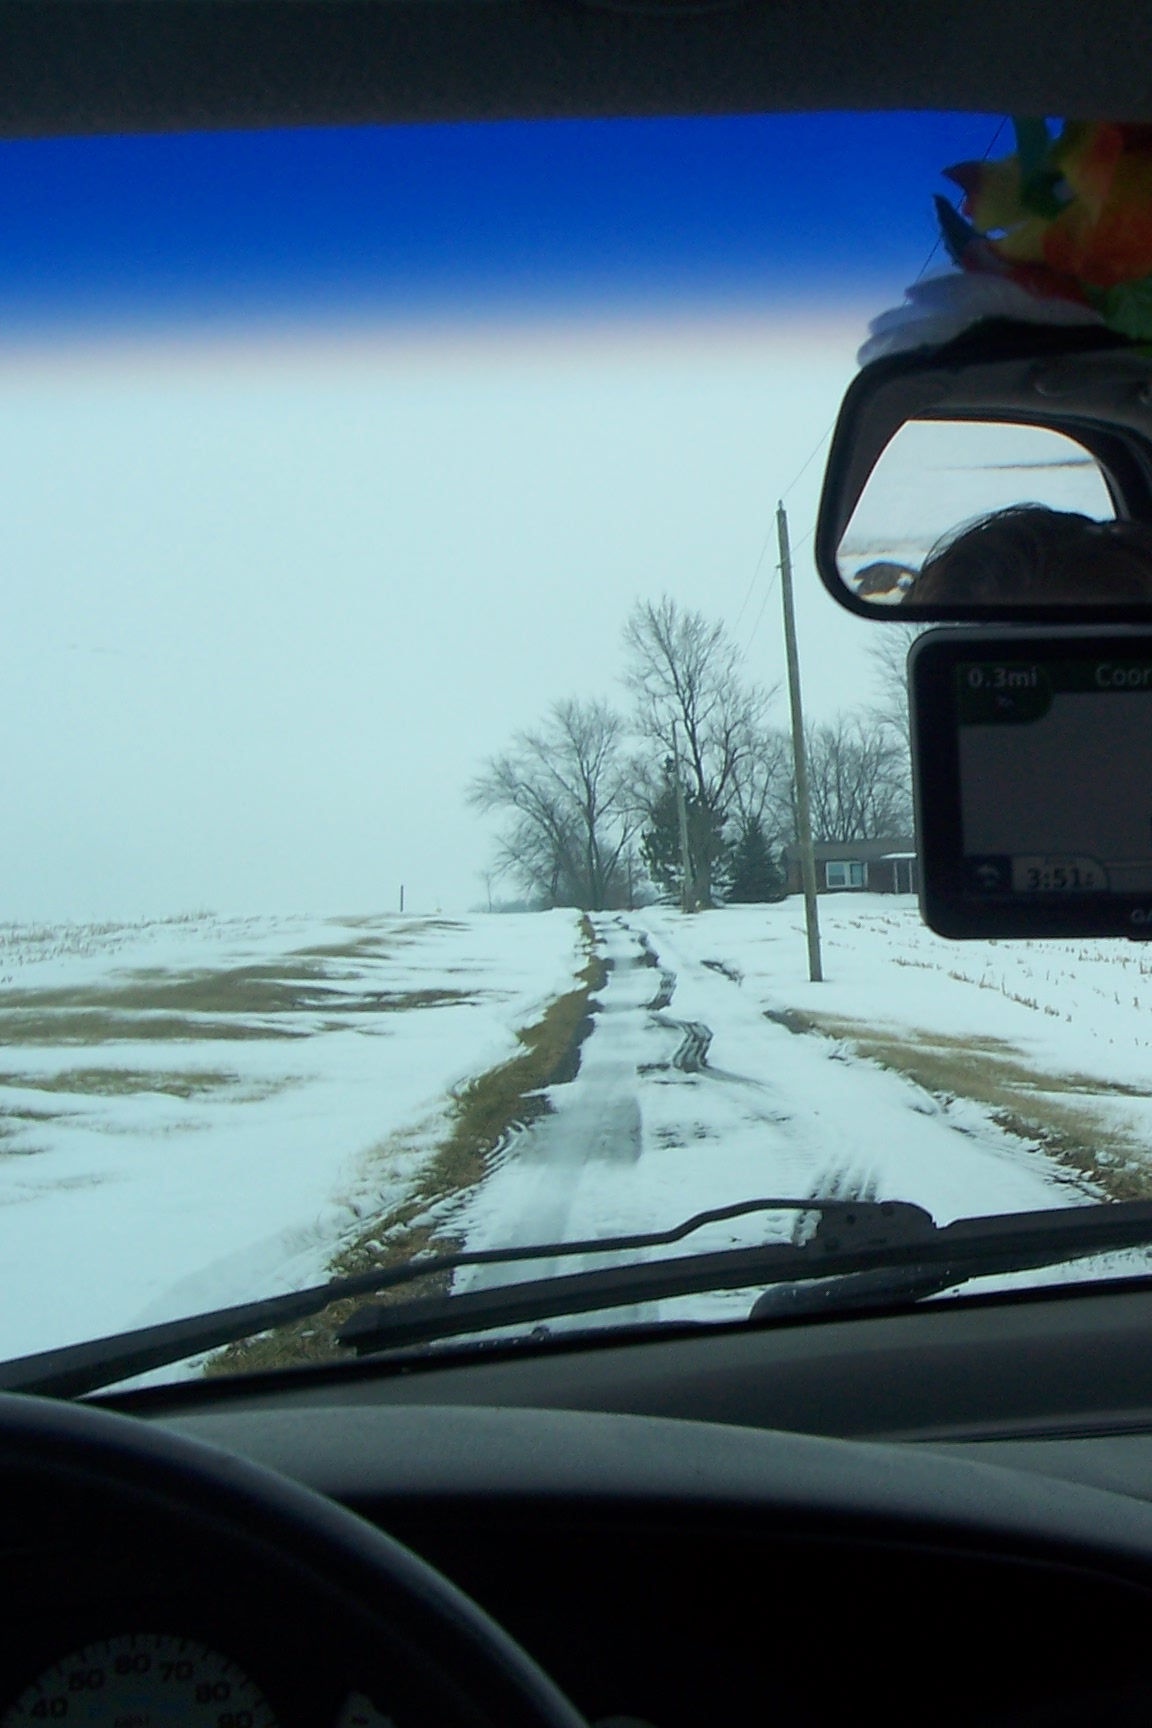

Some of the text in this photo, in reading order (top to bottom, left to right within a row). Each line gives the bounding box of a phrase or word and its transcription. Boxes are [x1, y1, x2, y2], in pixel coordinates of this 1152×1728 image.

[967, 665, 1038, 689] 0.3mi
[158, 1661, 194, 1683] 70
[32, 1696, 68, 1719] 40
